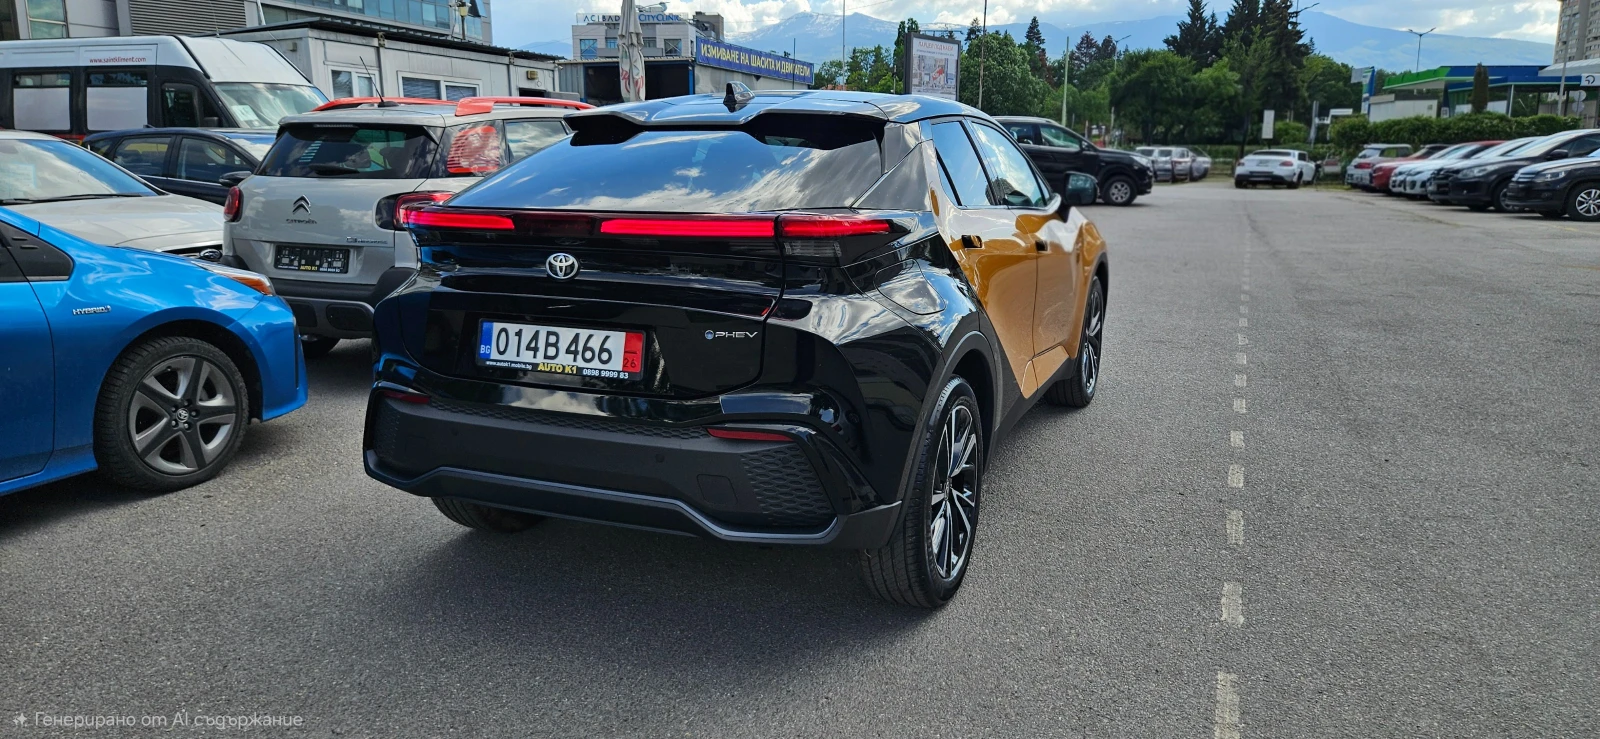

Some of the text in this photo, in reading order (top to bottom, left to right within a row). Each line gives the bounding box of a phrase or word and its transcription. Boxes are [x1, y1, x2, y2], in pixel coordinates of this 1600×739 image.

[583, 14, 621, 22] ACIBAD
[701, 43, 739, 63] ИЗМИВАНЕ
[740, 52, 750, 65] НА
[750, 55, 775, 70] ШАСИТА
[775, 61, 782, 71] И
[72, 306, 107, 315] HYBRID
[480, 344, 491, 354] BG
[623, 357, 637, 369] 26
[537, 362, 563, 374] AUTO
[564, 366, 578, 375] K1
[582, 368, 600, 377] 0898
[600, 370, 619, 378] 9999
[619, 372, 629, 380] 83
